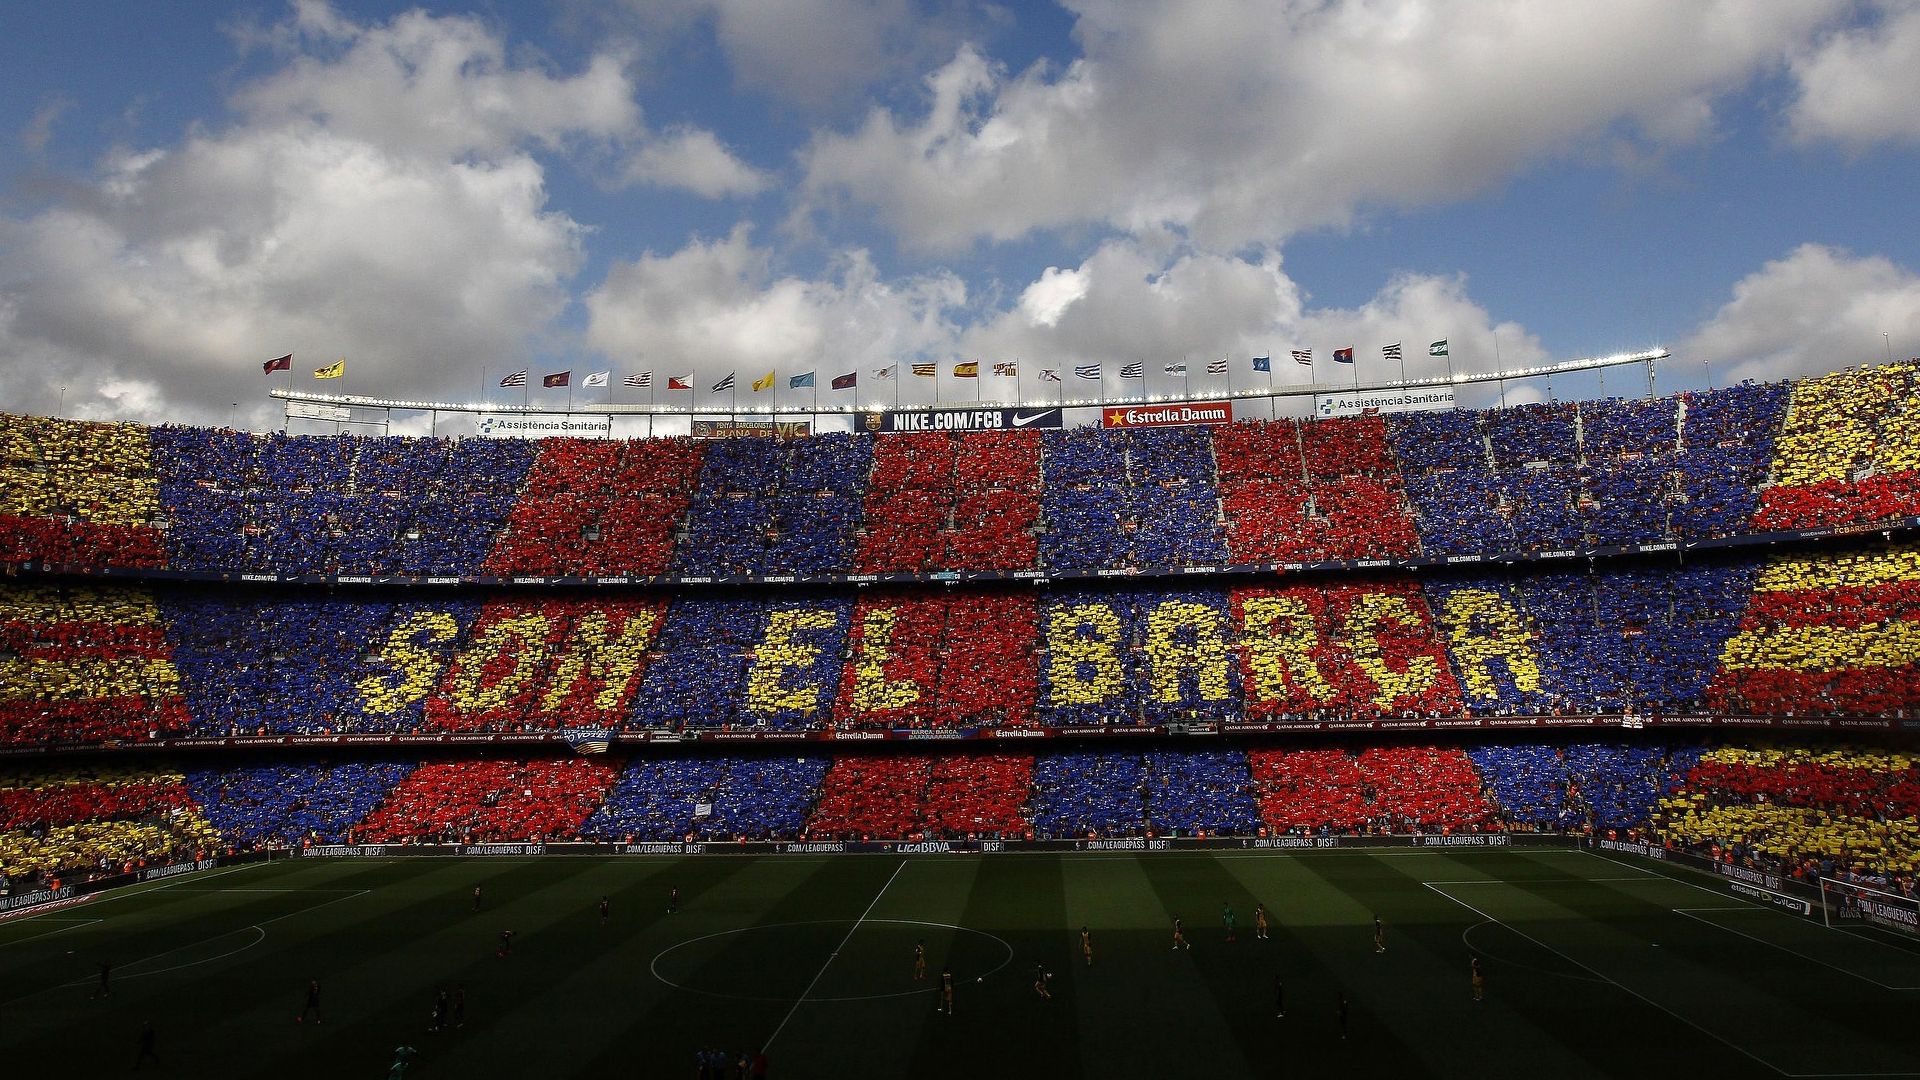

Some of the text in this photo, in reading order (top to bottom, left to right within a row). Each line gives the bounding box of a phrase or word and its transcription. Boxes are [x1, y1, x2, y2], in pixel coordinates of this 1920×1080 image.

[1338, 392, 1454, 409] Assistència Sanitària
[893, 410, 1002, 431] NIKE.COM/FCB
[1126, 406, 1226, 424] Estrella Damm
[498, 420, 607, 431] Assistència Sanitària
[776, 422, 806, 437] VIC
[1834, 520, 1906, 535] FCBARCELONA.CAT
[747, 606, 920, 714] EL
[836, 731, 884, 740] Estrella Damm
[996, 729, 1022, 738] Estrella
[1730, 883, 1760, 898] etisalat
